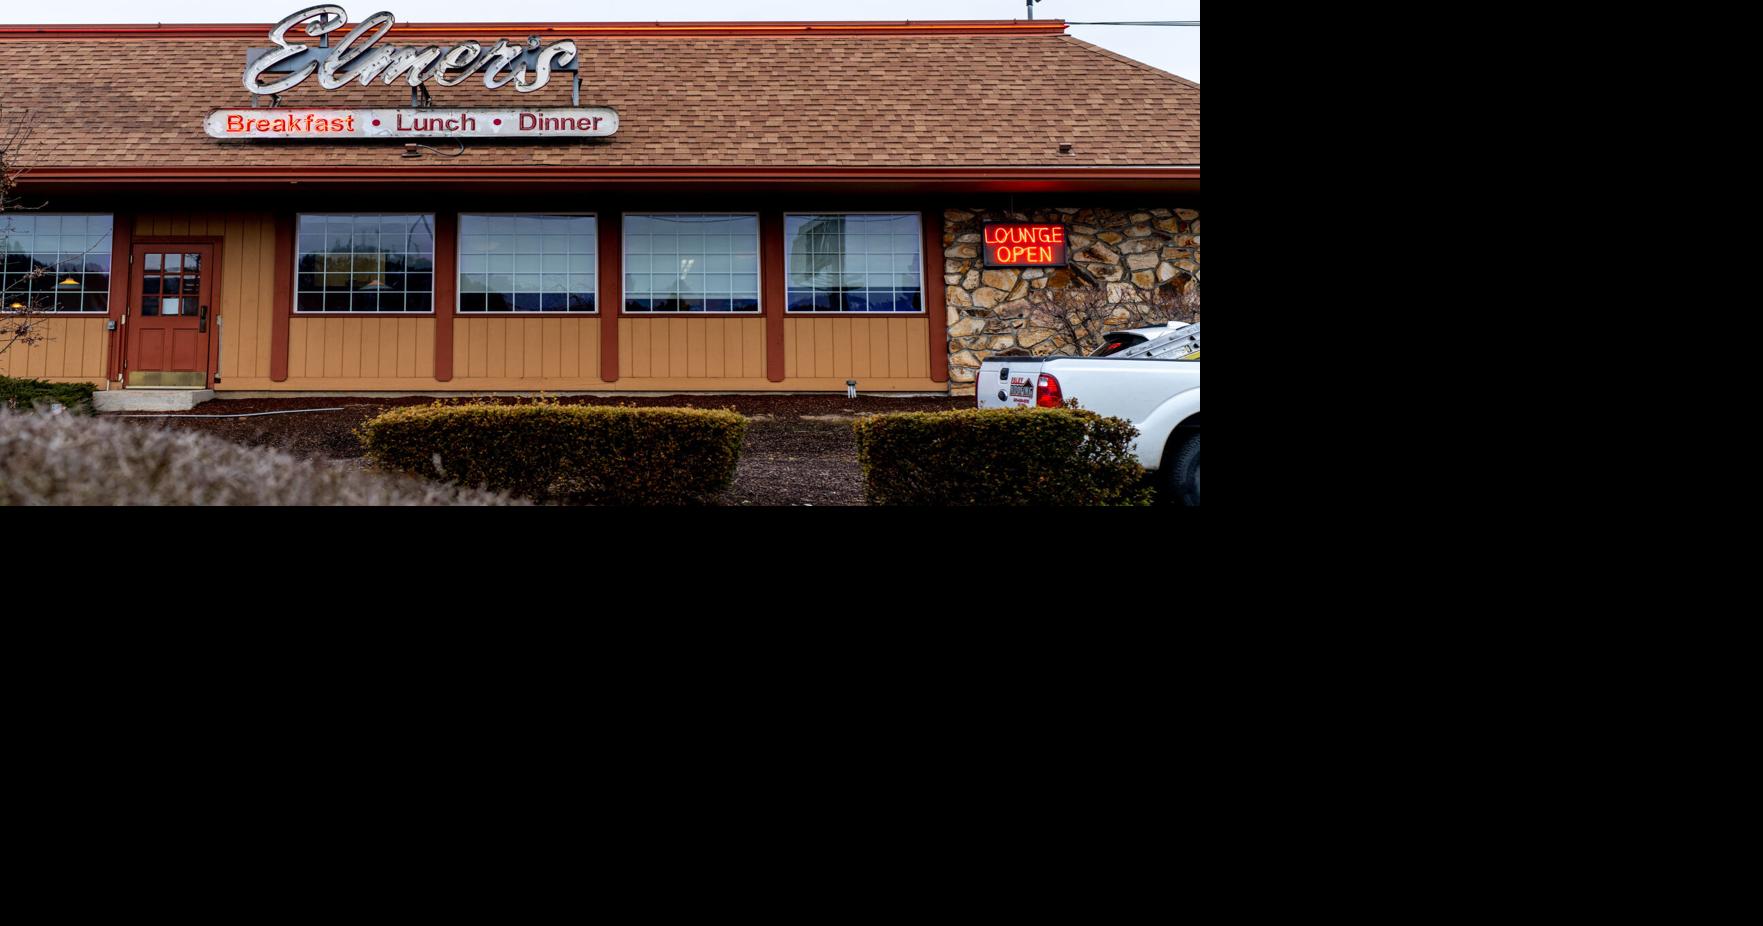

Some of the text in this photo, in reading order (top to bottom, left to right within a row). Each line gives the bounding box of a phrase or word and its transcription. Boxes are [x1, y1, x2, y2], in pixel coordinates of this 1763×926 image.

[243, 4, 577, 94] Elmer's
[226, 113, 603, 132] Breakfast Lunch Dinner
[984, 227, 1063, 243] LOUNGE
[997, 246, 1052, 262] OPEN
